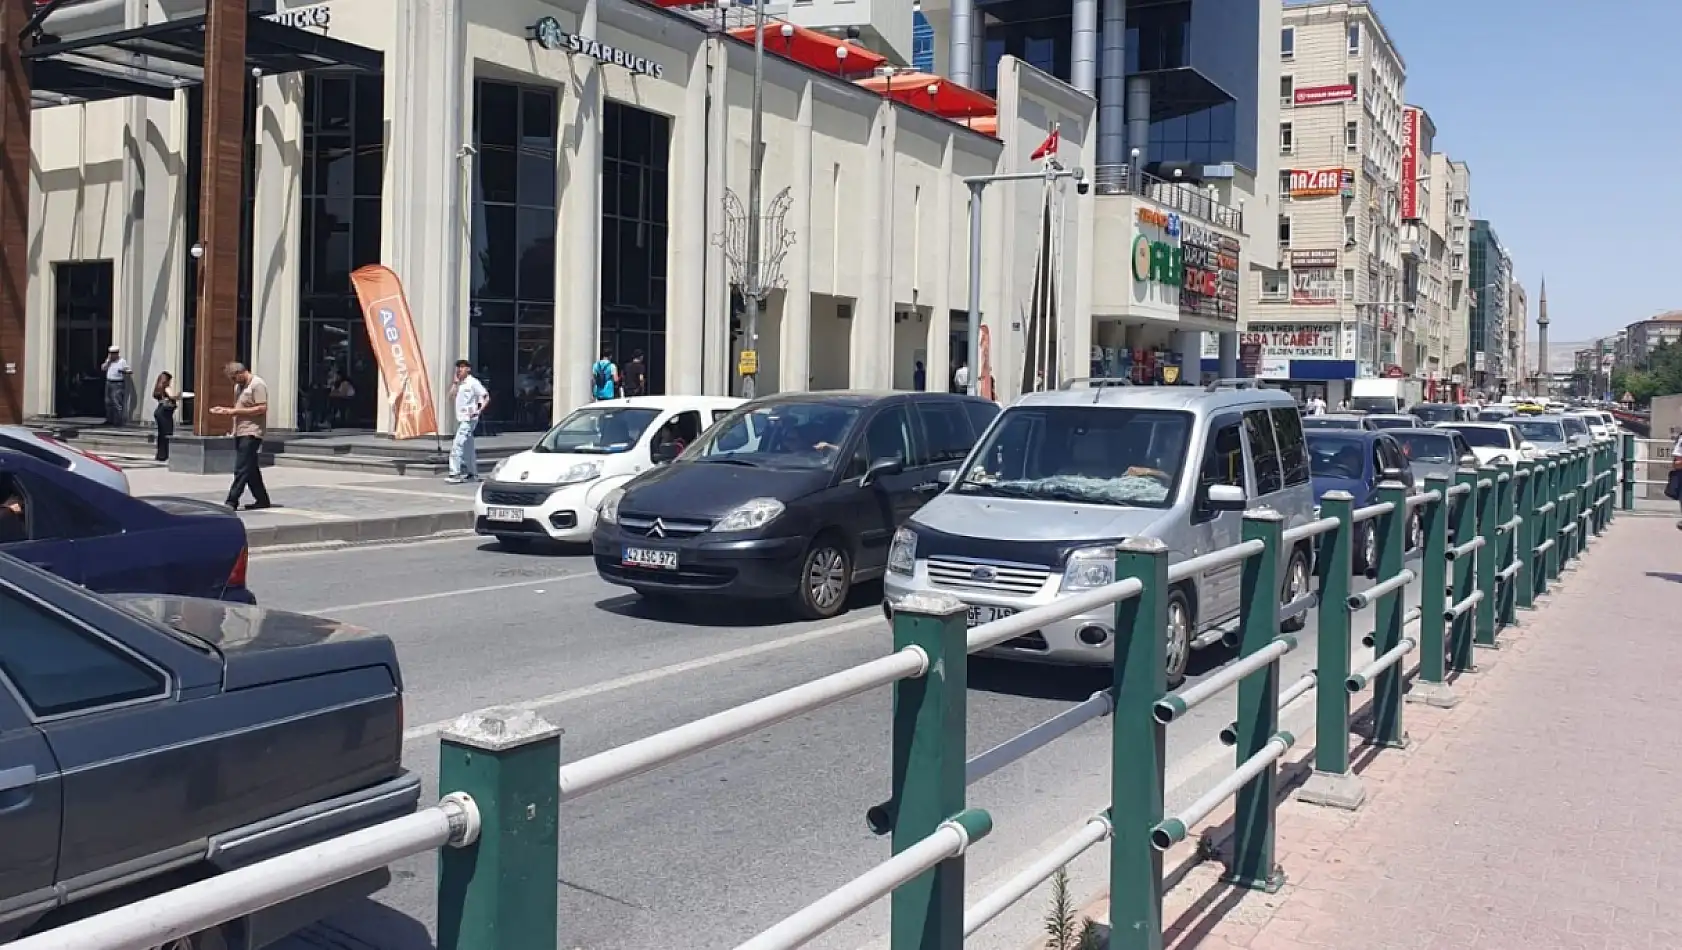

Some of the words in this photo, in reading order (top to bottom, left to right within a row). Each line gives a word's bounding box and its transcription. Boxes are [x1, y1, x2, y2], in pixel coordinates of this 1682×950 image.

[569, 34, 664, 79] STARBUCKS
[1402, 111, 1414, 159] ESRA
[1240, 333, 1268, 346] ESRA
[627, 547, 638, 561] 42
[640, 549, 657, 563] ASC
[659, 551, 676, 566] 972
